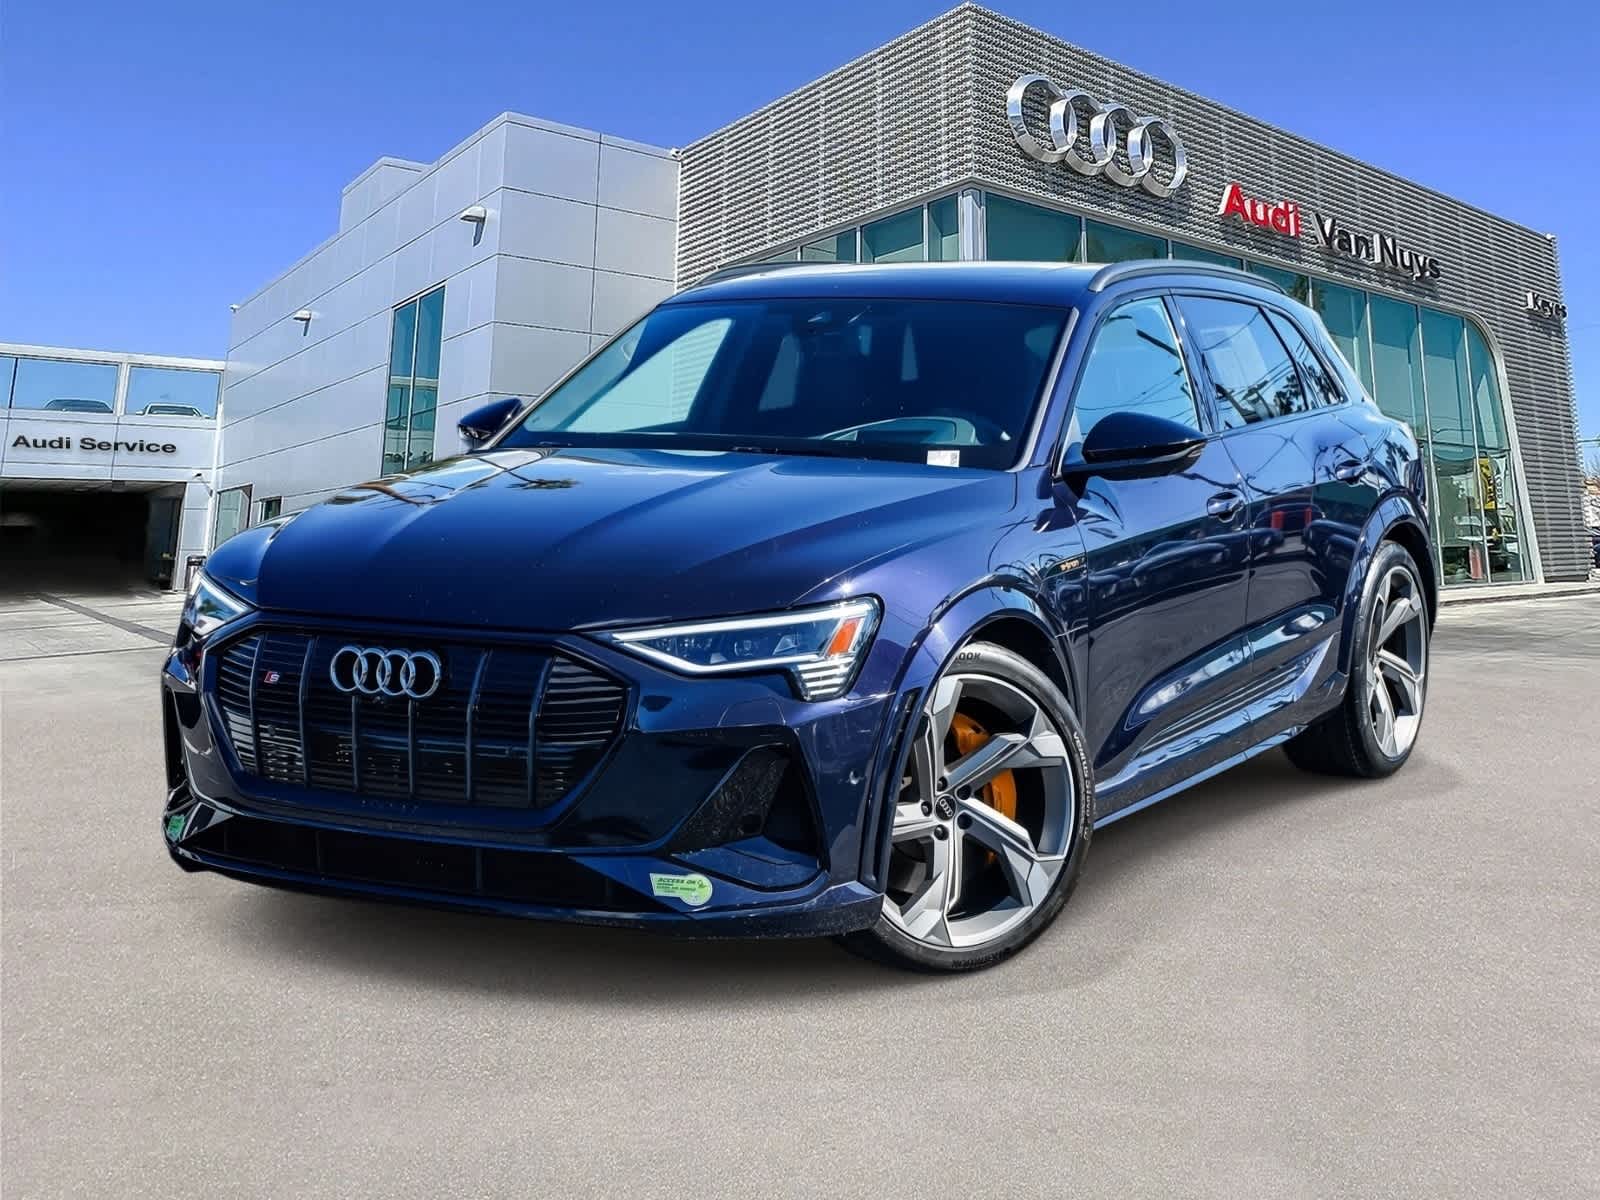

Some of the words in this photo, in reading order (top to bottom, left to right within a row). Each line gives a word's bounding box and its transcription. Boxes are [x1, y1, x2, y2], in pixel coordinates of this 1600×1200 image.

[1217, 182, 1301, 238] Audi
[1311, 212, 1370, 260] Van
[1374, 233, 1441, 281] Nuys
[12, 434, 71, 449] Audi
[79, 437, 177, 454] Service
